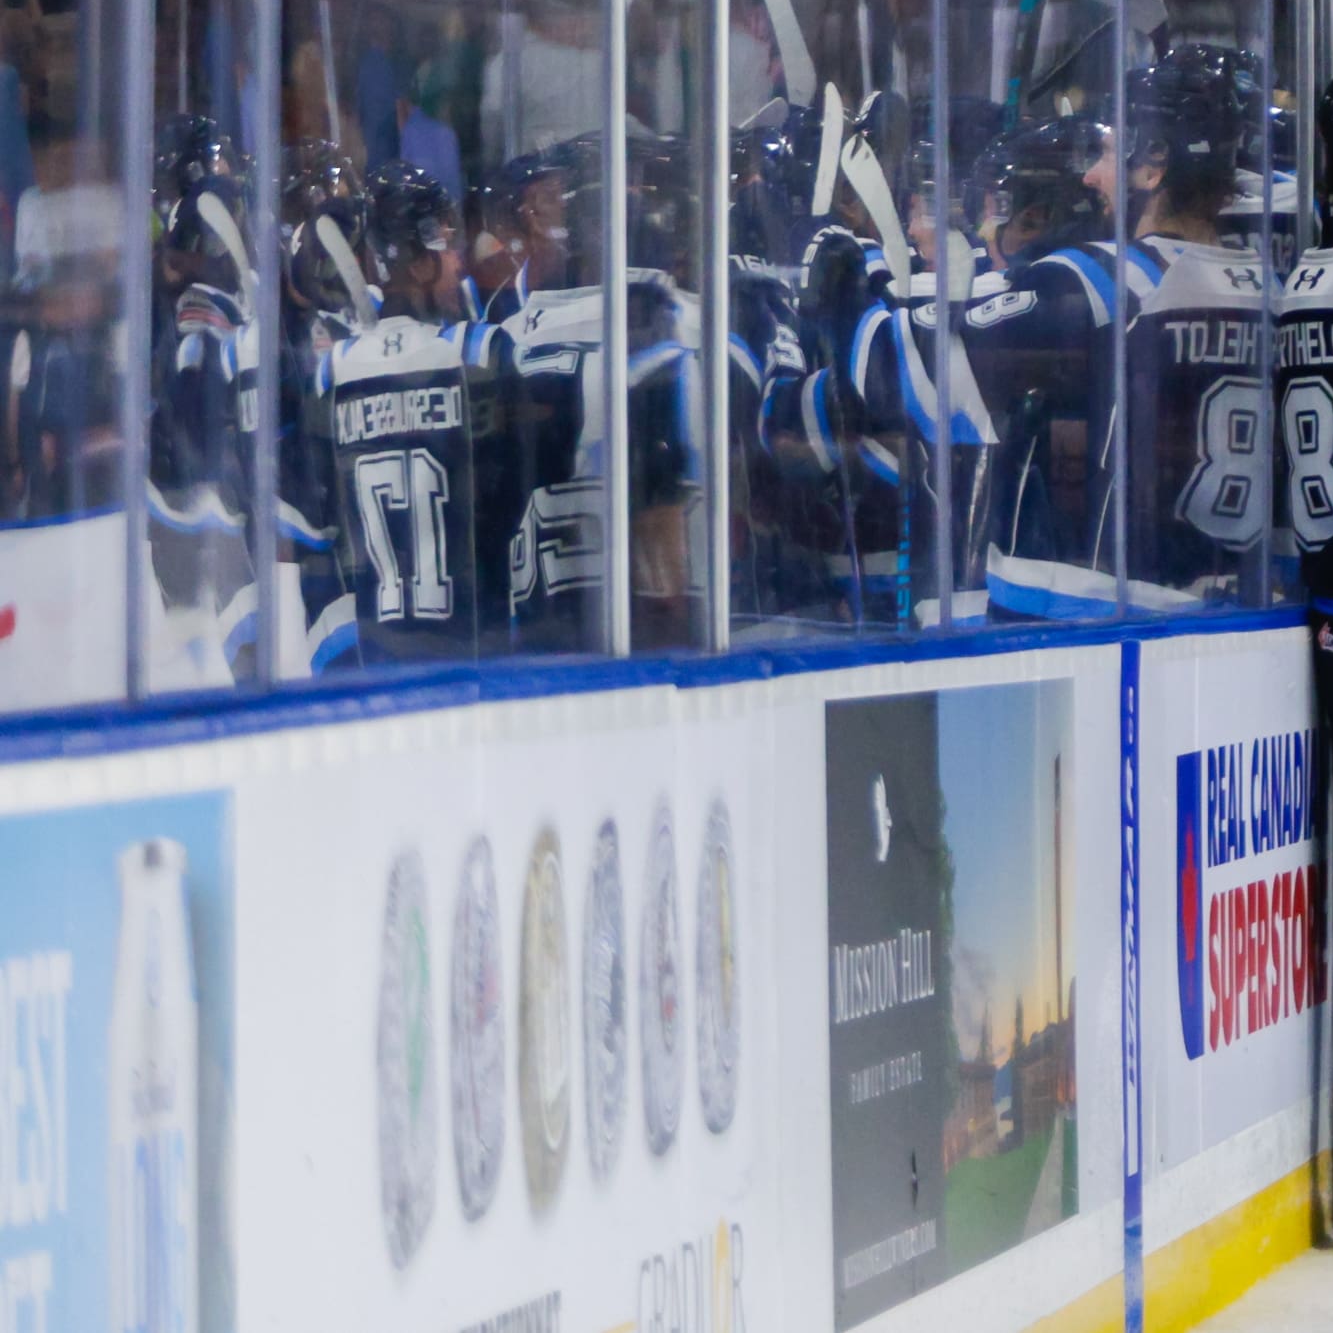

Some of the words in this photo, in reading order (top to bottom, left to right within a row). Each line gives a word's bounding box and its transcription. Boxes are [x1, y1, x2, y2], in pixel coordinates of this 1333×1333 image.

[1207, 742, 1247, 868] REAL
[835, 939, 898, 1024] MISSION
[901, 927, 935, 1003] HILL
